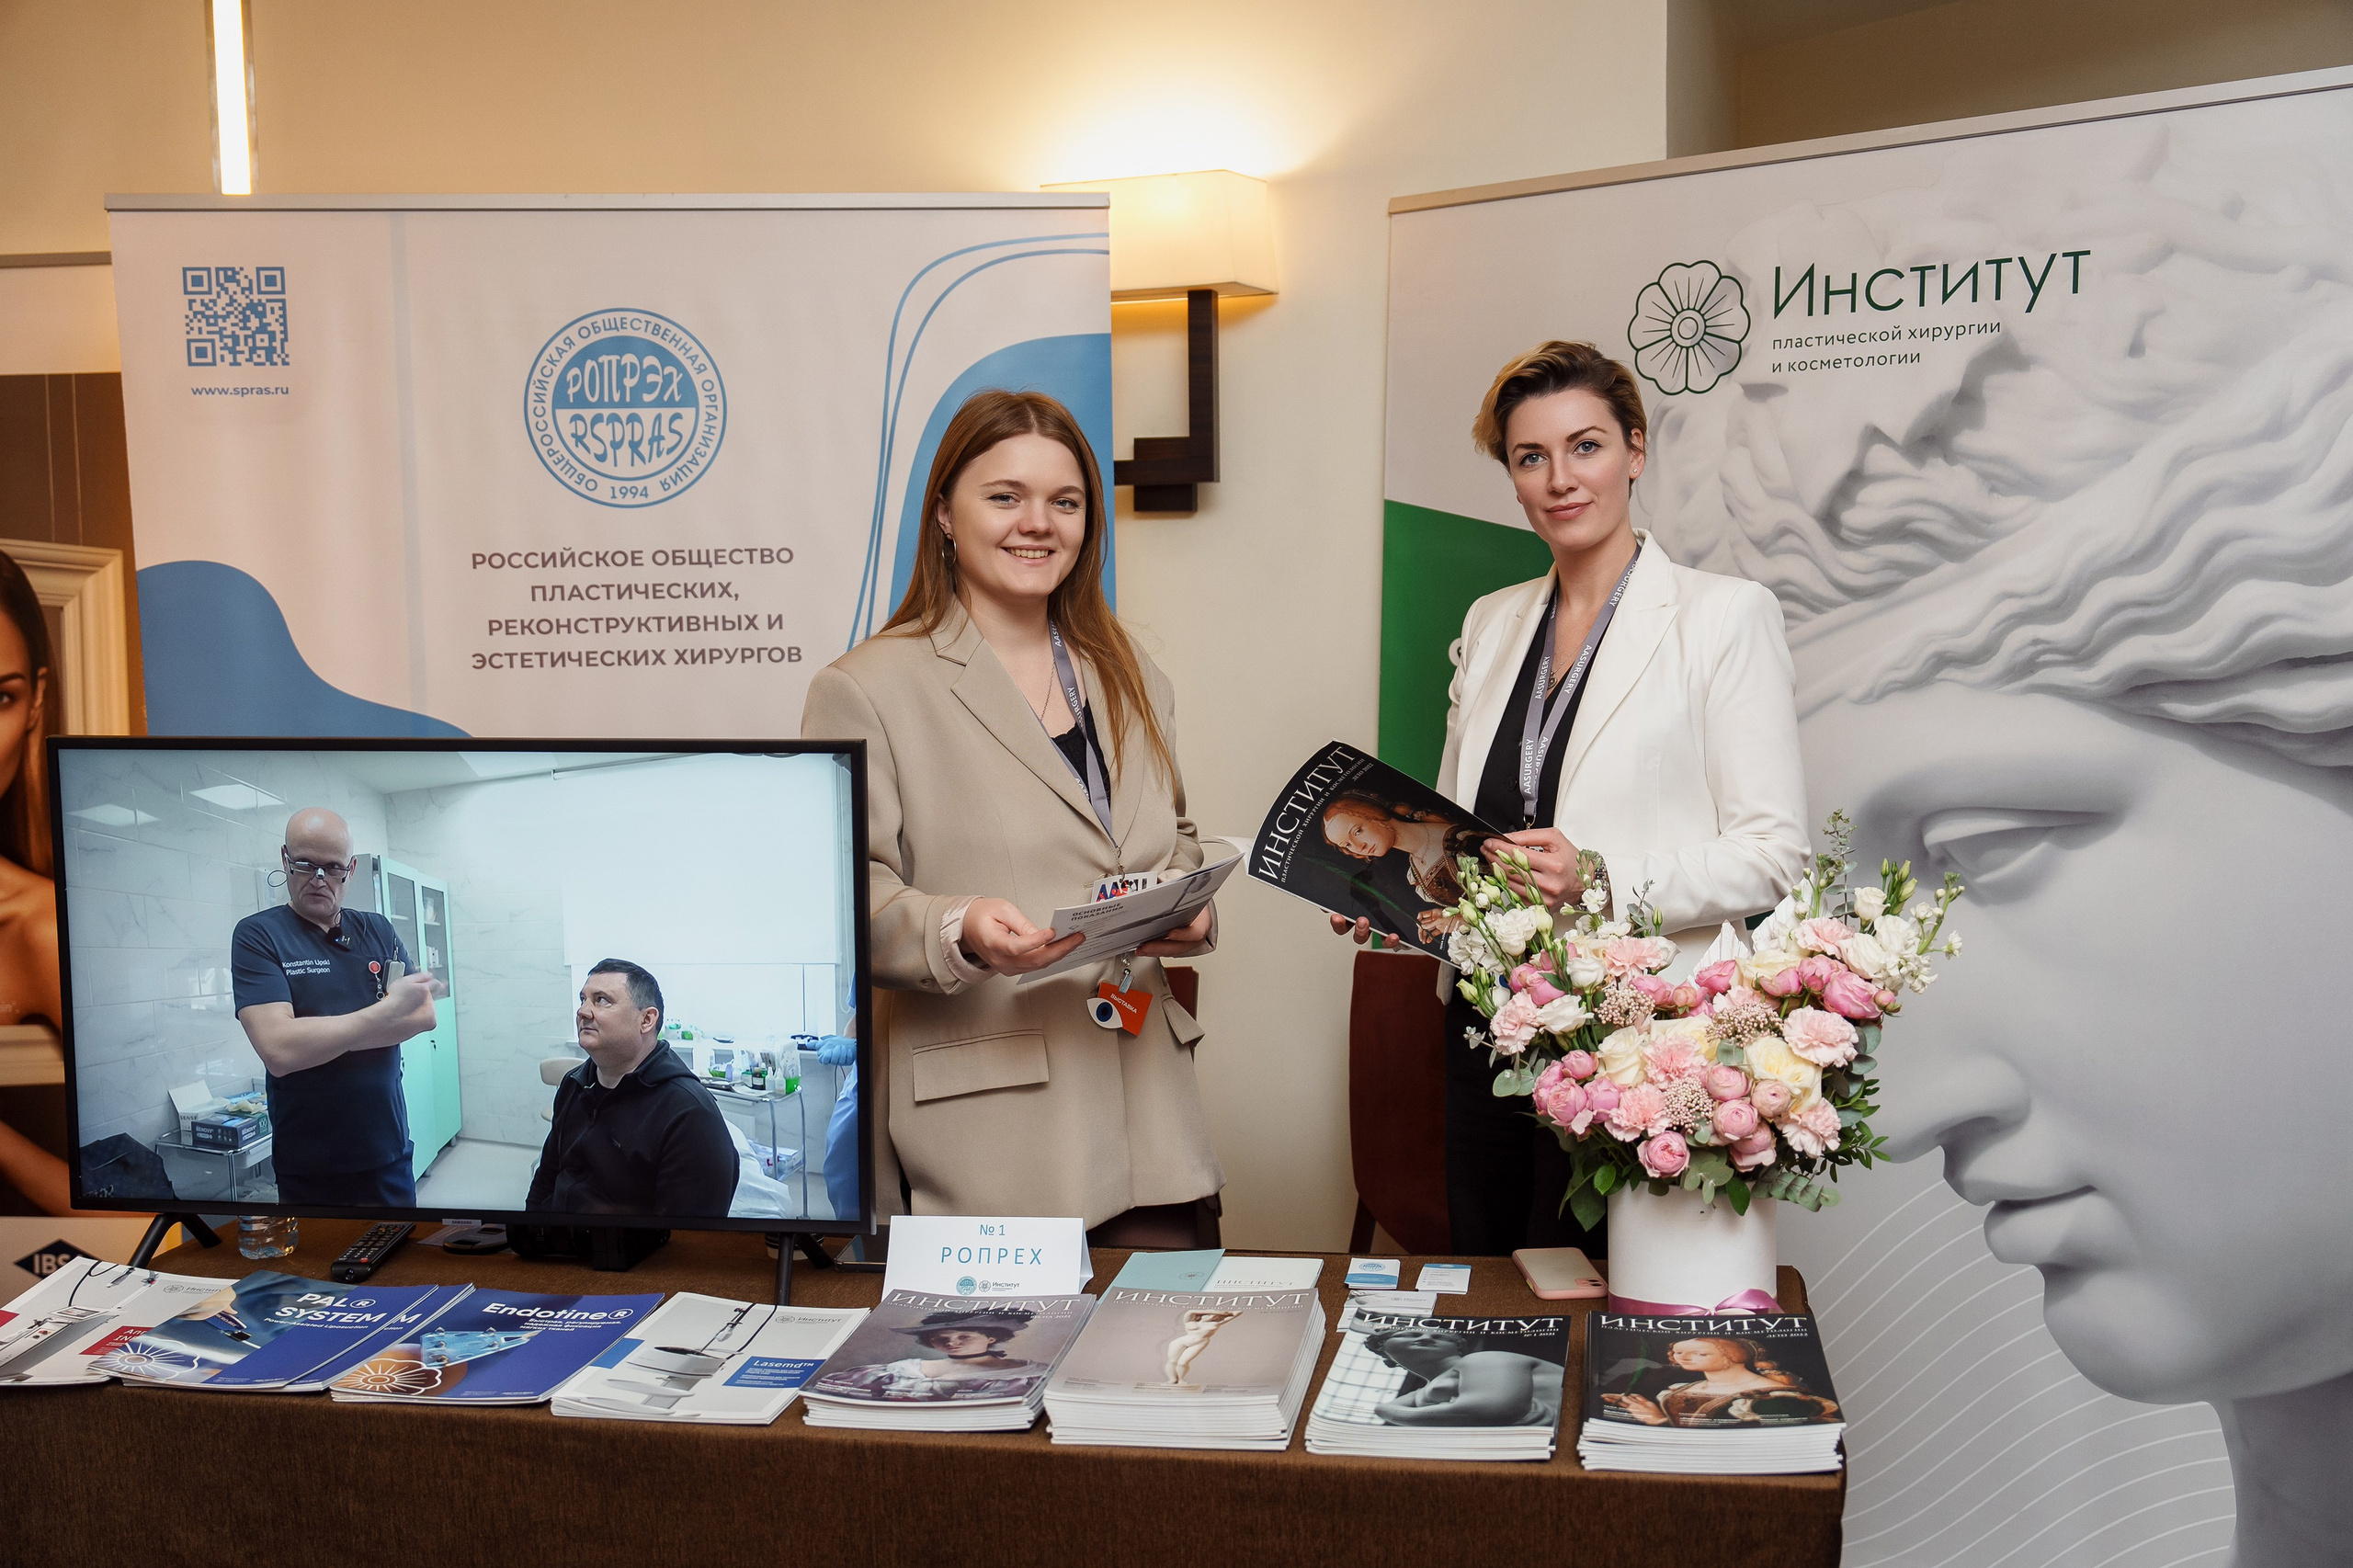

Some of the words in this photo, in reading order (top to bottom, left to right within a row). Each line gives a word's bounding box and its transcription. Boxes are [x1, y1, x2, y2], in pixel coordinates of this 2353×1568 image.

[1773, 250, 2091, 319] Институт
[1772, 325, 1903, 350] пластической
[1907, 321, 2001, 342] хирургии
[1772, 361, 1782, 373] и
[1787, 350, 1921, 373] косметологии
[191, 386, 290, 397] www.spras.ru
[532, 335, 598, 492] ОБЩЕРОССИЙСКАЯ
[577, 316, 708, 375] ОБЩЕСТВЕННАЯ
[659, 379, 718, 492] ОРГАНИЗАЦИЯ
[569, 412, 683, 467] RSPRAS
[609, 485, 650, 500] 1994
[472, 547, 644, 569] РОССИЙСКОЕ
[652, 547, 794, 568] ОБЩЕСТВО
[530, 581, 739, 602] ПЛАСТИЧЕСКИХ,
[488, 614, 759, 636] РЕКОНСТРУКТИВНЫХ
[767, 613, 784, 631] И
[472, 649, 667, 670] ЭСТЕТИЧЕСКИХ
[674, 646, 802, 665] ХИРУРГОВ
[1535, 655, 1551, 699] AASURGERY
[1563, 644, 1593, 694] AASURGERY
[1523, 738, 1535, 794] AASURGERY
[1258, 746, 1356, 880] ИНСТИТУТ
[1281, 829, 1304, 883] ПЛАСТИЧЕСКОЙ
[1302, 797, 1325, 827] ХИРУРГИИ
[1329, 758, 1365, 790] КОСМЕТОЛОГИИ
[1071, 906, 1123, 921] ПОКАЗАНИЯ
[1073, 903, 1121, 916] ОСНОВНЫЕ
[282, 960, 313, 968] Konstantin
[286, 967, 306, 975] Plastic
[1110, 994, 1138, 1014] ВЫСТАВКА
[980, 1224, 995, 1235] №
[999, 1224, 1006, 1235] 1
[34, 1254, 74, 1274] IBS
[941, 1246, 1042, 1265] РОПРЕХ
[892, 1292, 1080, 1312] ИНСТИТУТ
[1115, 1290, 1310, 1307] ИНСТИТУТ
[264, 1317, 324, 1328] Power-Assisted
[275, 1306, 388, 1324] SYSTEM
[1363, 1313, 1563, 1331] ИНСТИТУТ
[1600, 1315, 1807, 1331] ИНСТИТУТ
